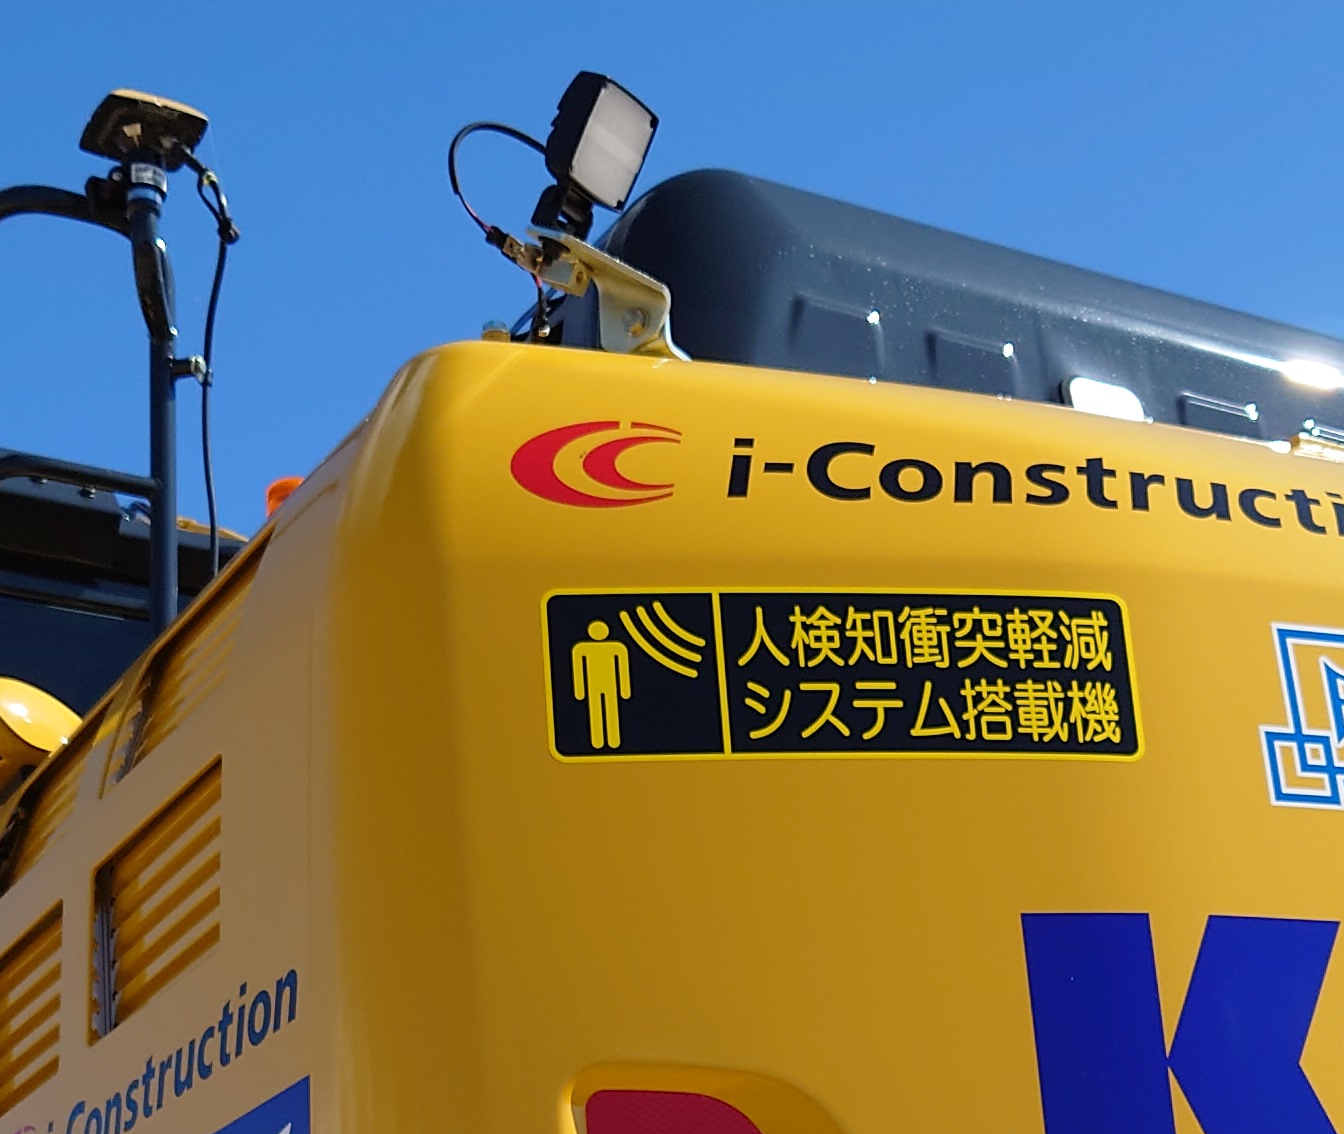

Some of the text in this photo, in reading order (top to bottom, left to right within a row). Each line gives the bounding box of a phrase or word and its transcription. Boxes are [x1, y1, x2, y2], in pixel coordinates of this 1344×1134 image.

[738, 605, 1112, 672] 人検知衝突軽減
[744, 678, 1122, 744] システム搭載機
